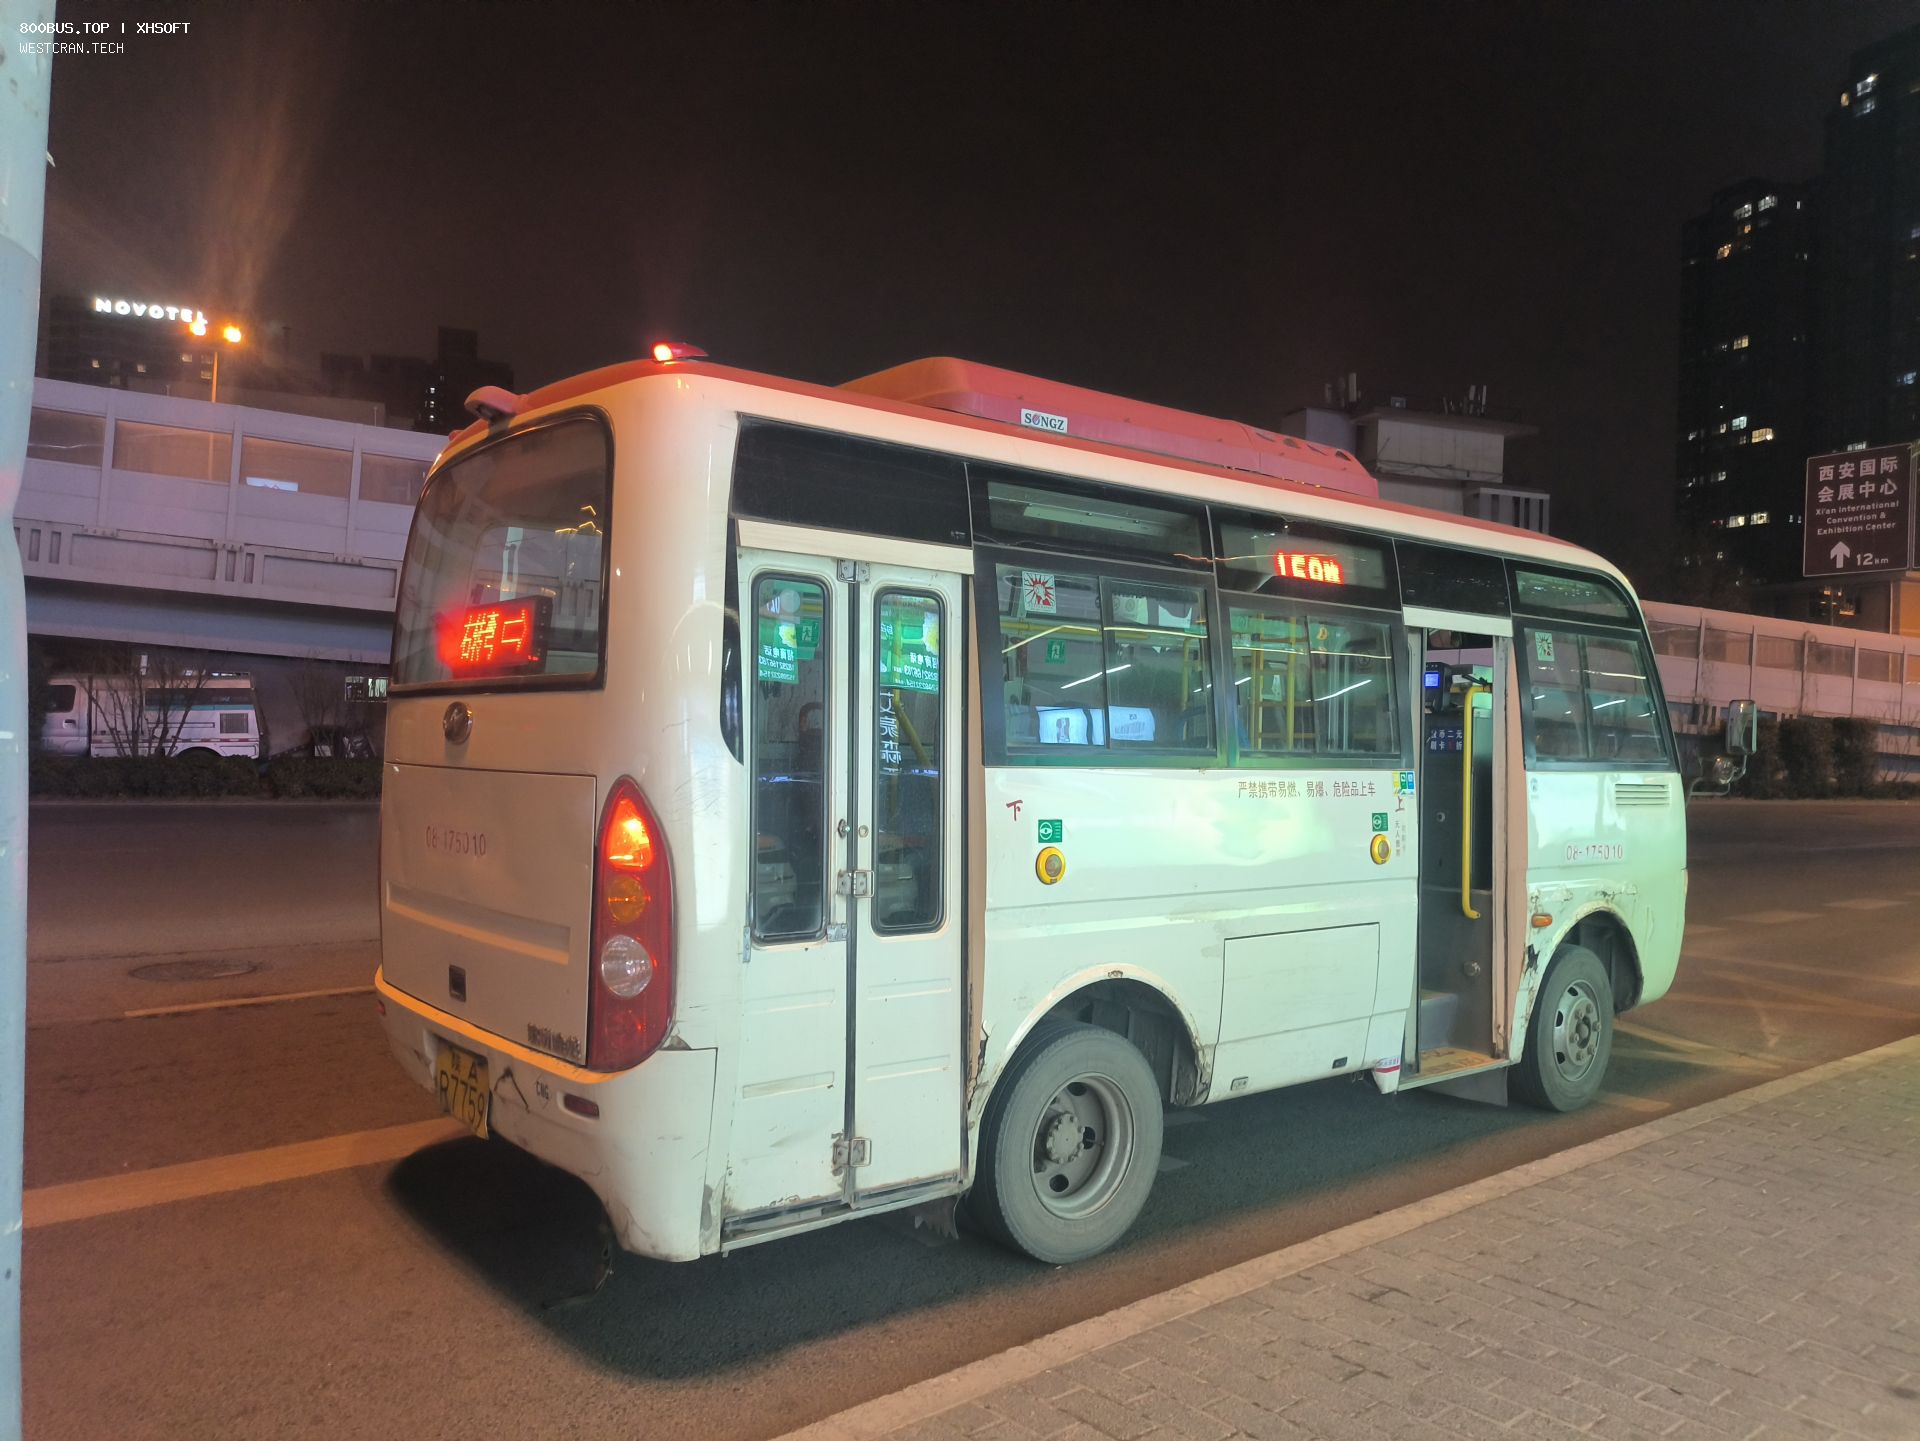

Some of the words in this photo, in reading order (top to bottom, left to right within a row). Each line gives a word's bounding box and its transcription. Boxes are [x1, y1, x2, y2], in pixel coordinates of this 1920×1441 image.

[95, 297, 208, 325] NOVOTEL
[1024, 412, 1065, 431] SONGZ
[1818, 456, 1898, 482] 西安国际
[1817, 478, 1898, 503] 会展中心
[1826, 512, 1877, 524] Convention
[1817, 525, 1863, 536] Exhibition
[1865, 522, 1896, 531] Center
[1238, 781, 1376, 799] 严禁携带易燃、易爆、危险品上车
[1006, 800, 1023, 821] 下
[1394, 796, 1405, 812] 上
